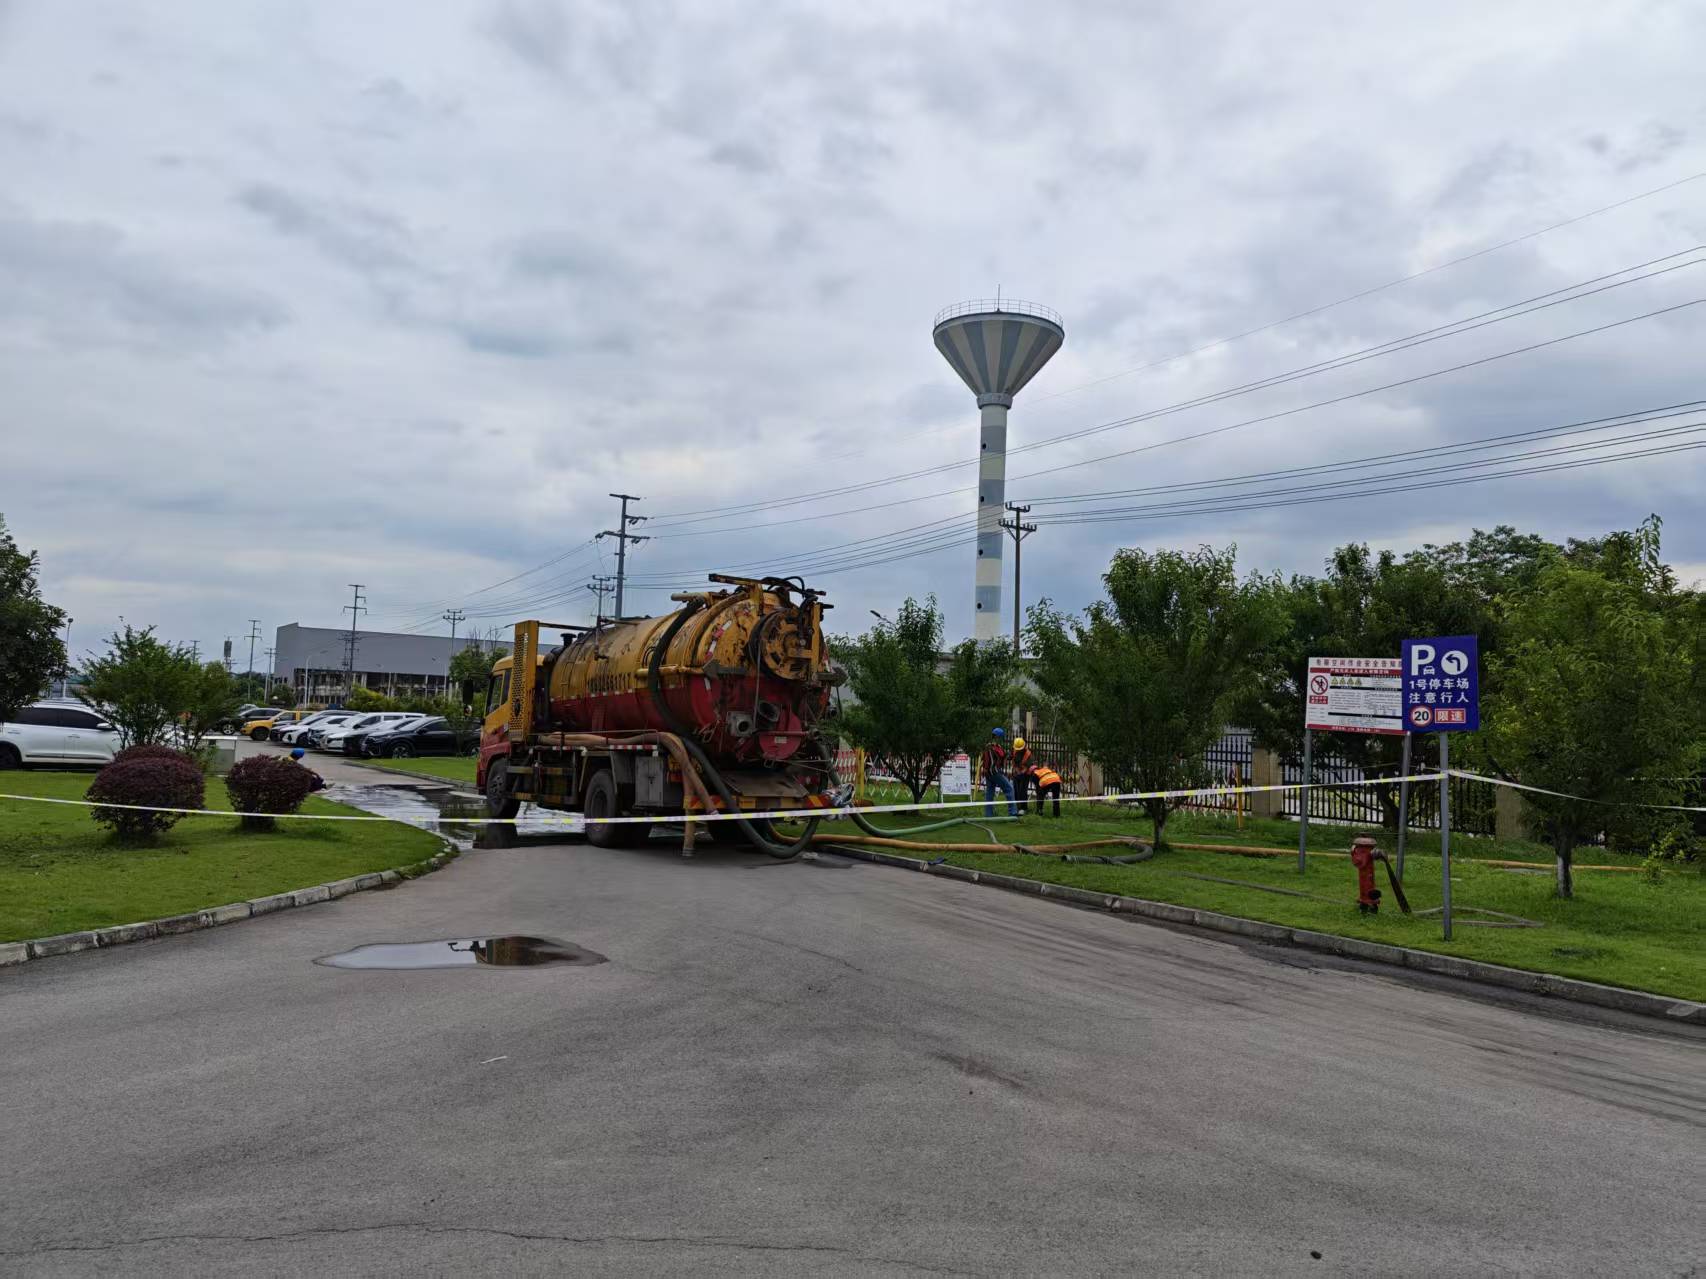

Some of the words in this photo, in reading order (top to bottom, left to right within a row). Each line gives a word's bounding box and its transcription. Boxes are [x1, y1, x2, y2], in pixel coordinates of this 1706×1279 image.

[1411, 645, 1435, 676] P
[1409, 678, 1469, 690] 1号停车场
[1409, 692, 1469, 704] 注意行人
[1414, 711, 1429, 721] 20
[1437, 711, 1463, 721] 限速
